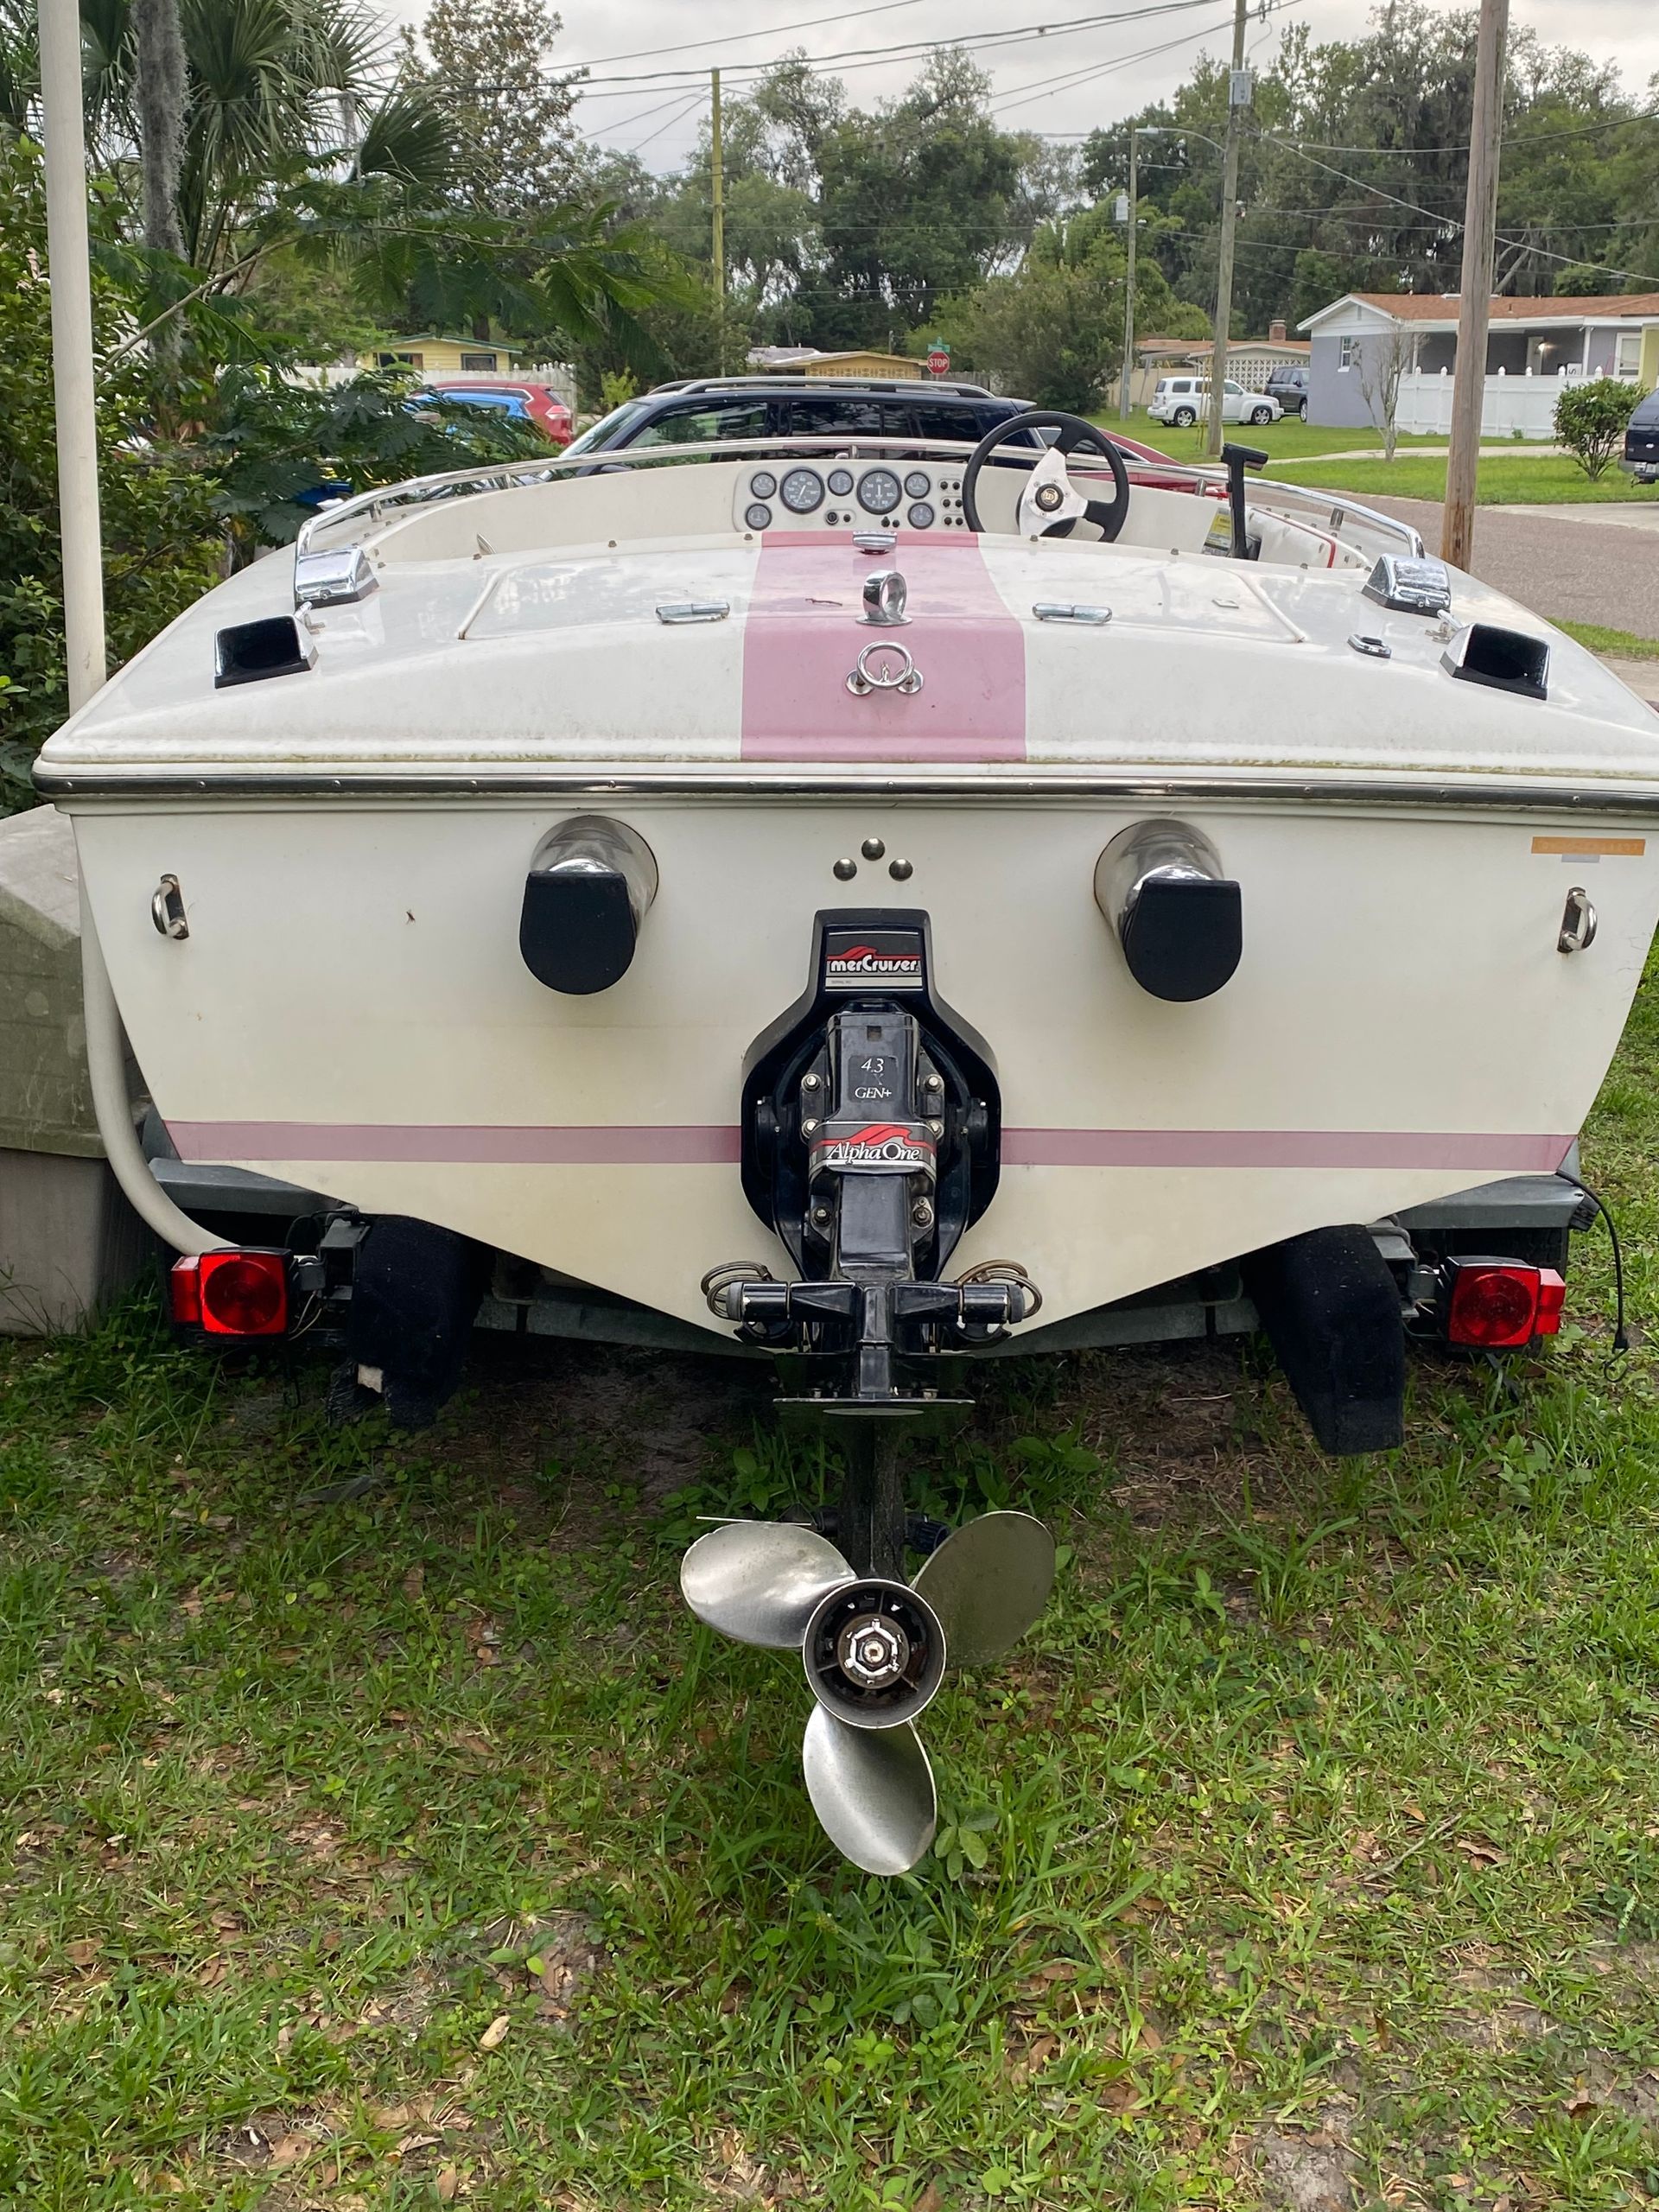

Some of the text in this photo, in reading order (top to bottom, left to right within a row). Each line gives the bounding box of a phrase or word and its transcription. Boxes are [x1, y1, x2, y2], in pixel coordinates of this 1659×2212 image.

[929, 358, 948, 368] STOP
[855, 1086, 893, 1099] GEN+
[827, 1141, 920, 1165] Alpha One
